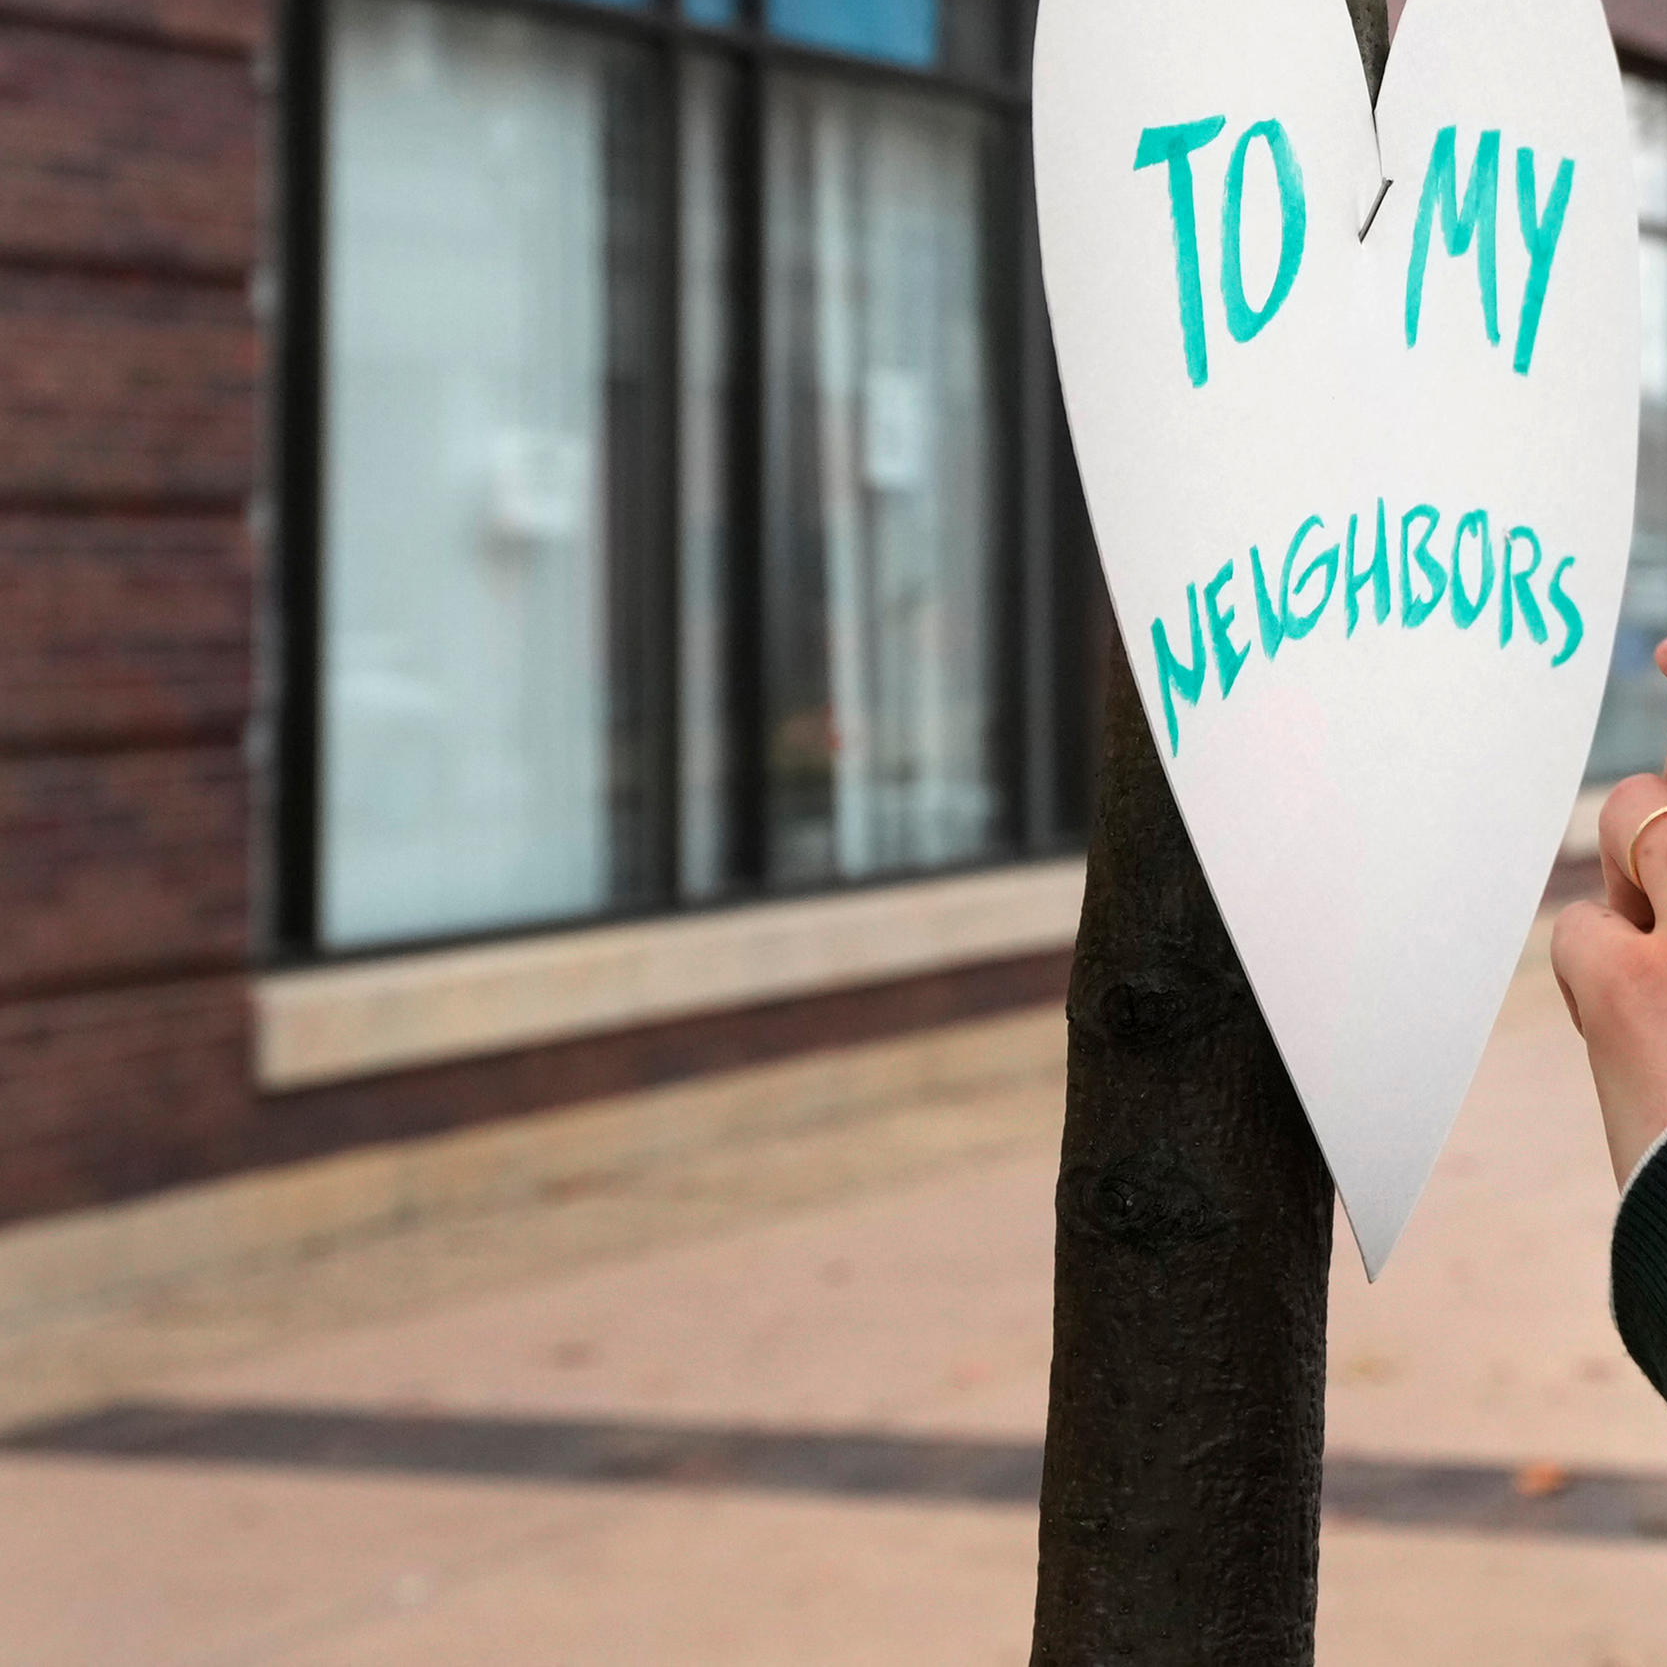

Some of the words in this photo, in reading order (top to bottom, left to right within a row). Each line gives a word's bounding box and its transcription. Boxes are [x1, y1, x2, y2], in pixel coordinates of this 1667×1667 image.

[1132, 114, 1308, 389] TO
[1404, 124, 1576, 377] MY
[1150, 496, 1585, 758] NEIGHBORS
